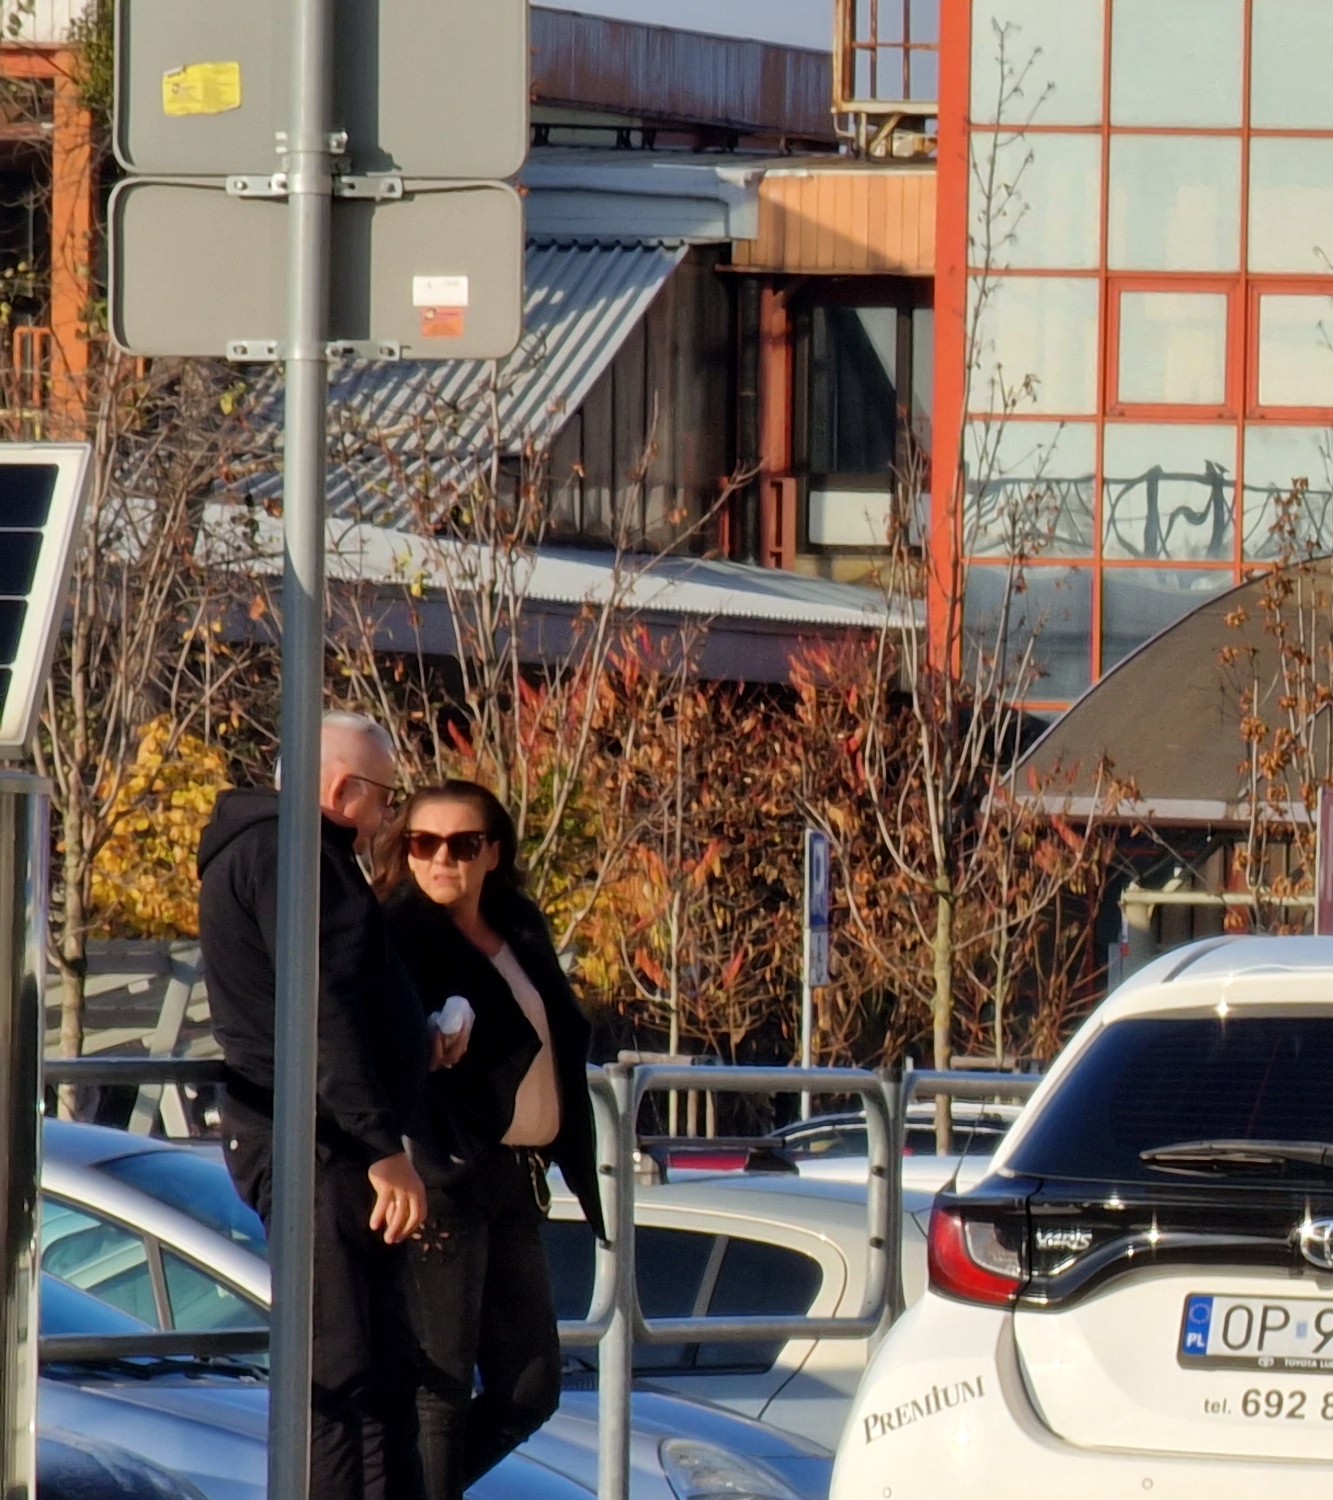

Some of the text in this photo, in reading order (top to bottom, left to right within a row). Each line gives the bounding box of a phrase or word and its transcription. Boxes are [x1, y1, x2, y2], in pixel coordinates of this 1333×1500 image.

[1186, 1332, 1206, 1348] PL
[1222, 1304, 1291, 1352] OP
[1284, 1358, 1317, 1368] TOYOTA
[1204, 1397, 1232, 1415] tel.
[1241, 1388, 1307, 1420] 692
